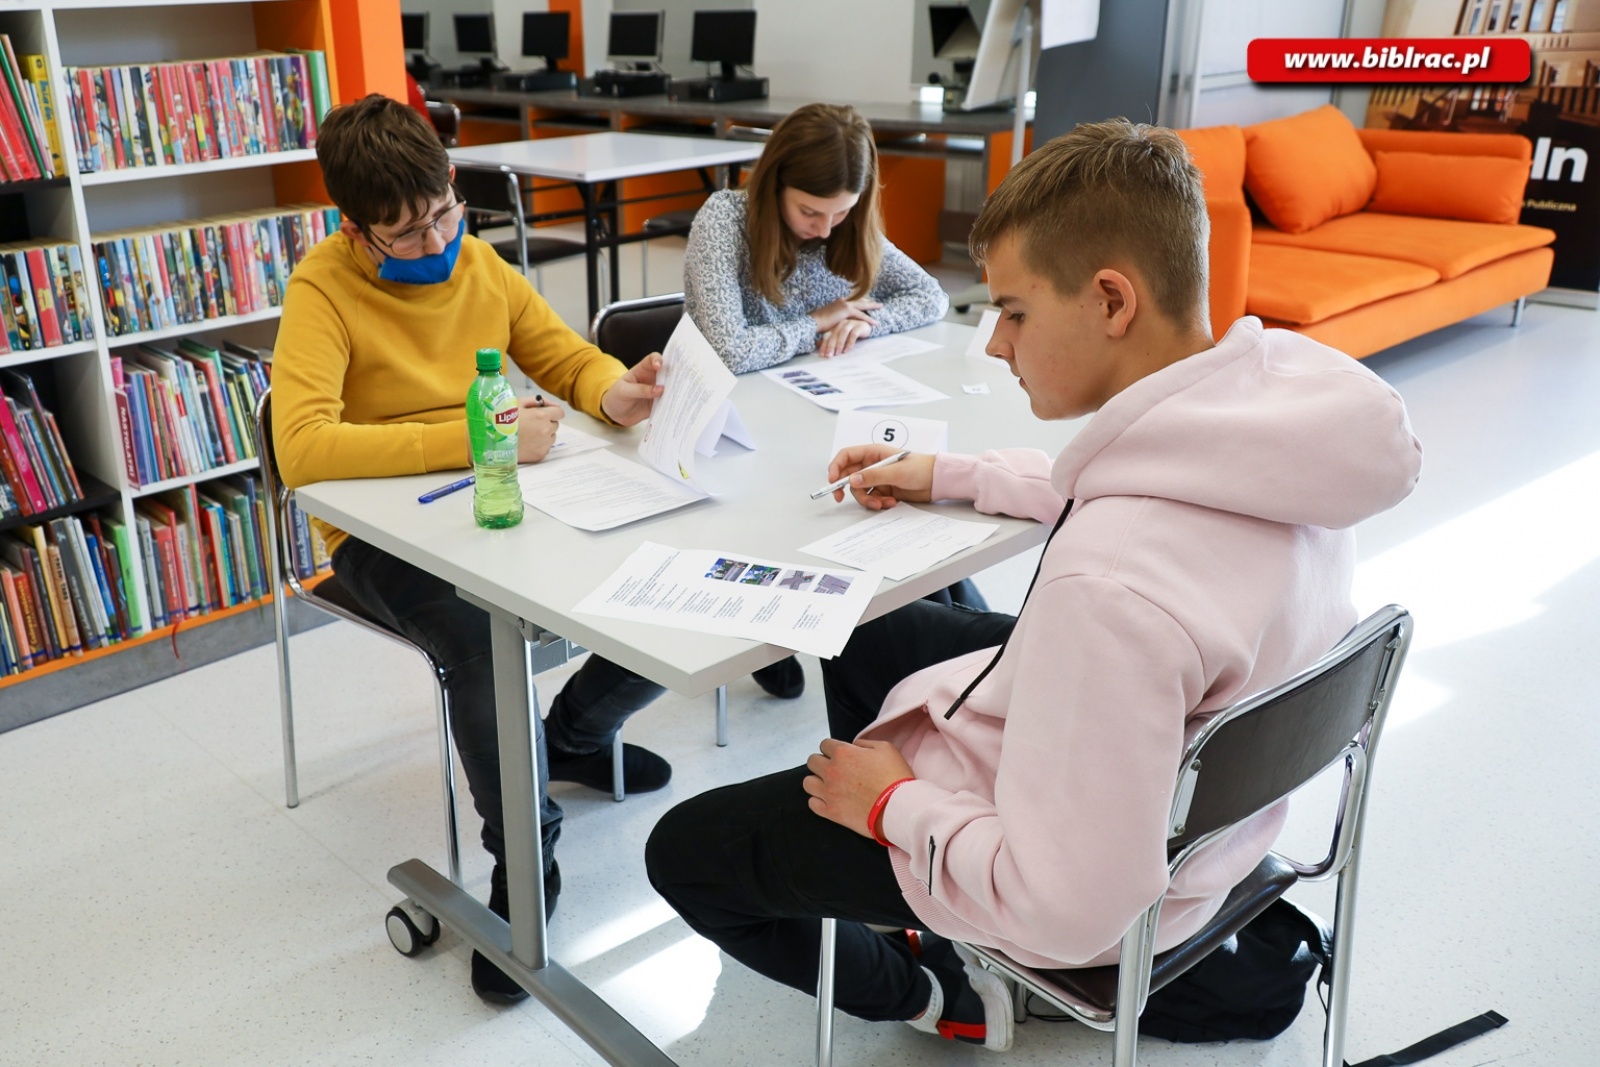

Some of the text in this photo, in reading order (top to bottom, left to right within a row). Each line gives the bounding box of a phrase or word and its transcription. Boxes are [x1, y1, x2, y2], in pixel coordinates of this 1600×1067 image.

[1527, 199, 1577, 213] Publiczna
[498, 410, 518, 423] Lipto
[882, 427, 896, 443] 5
